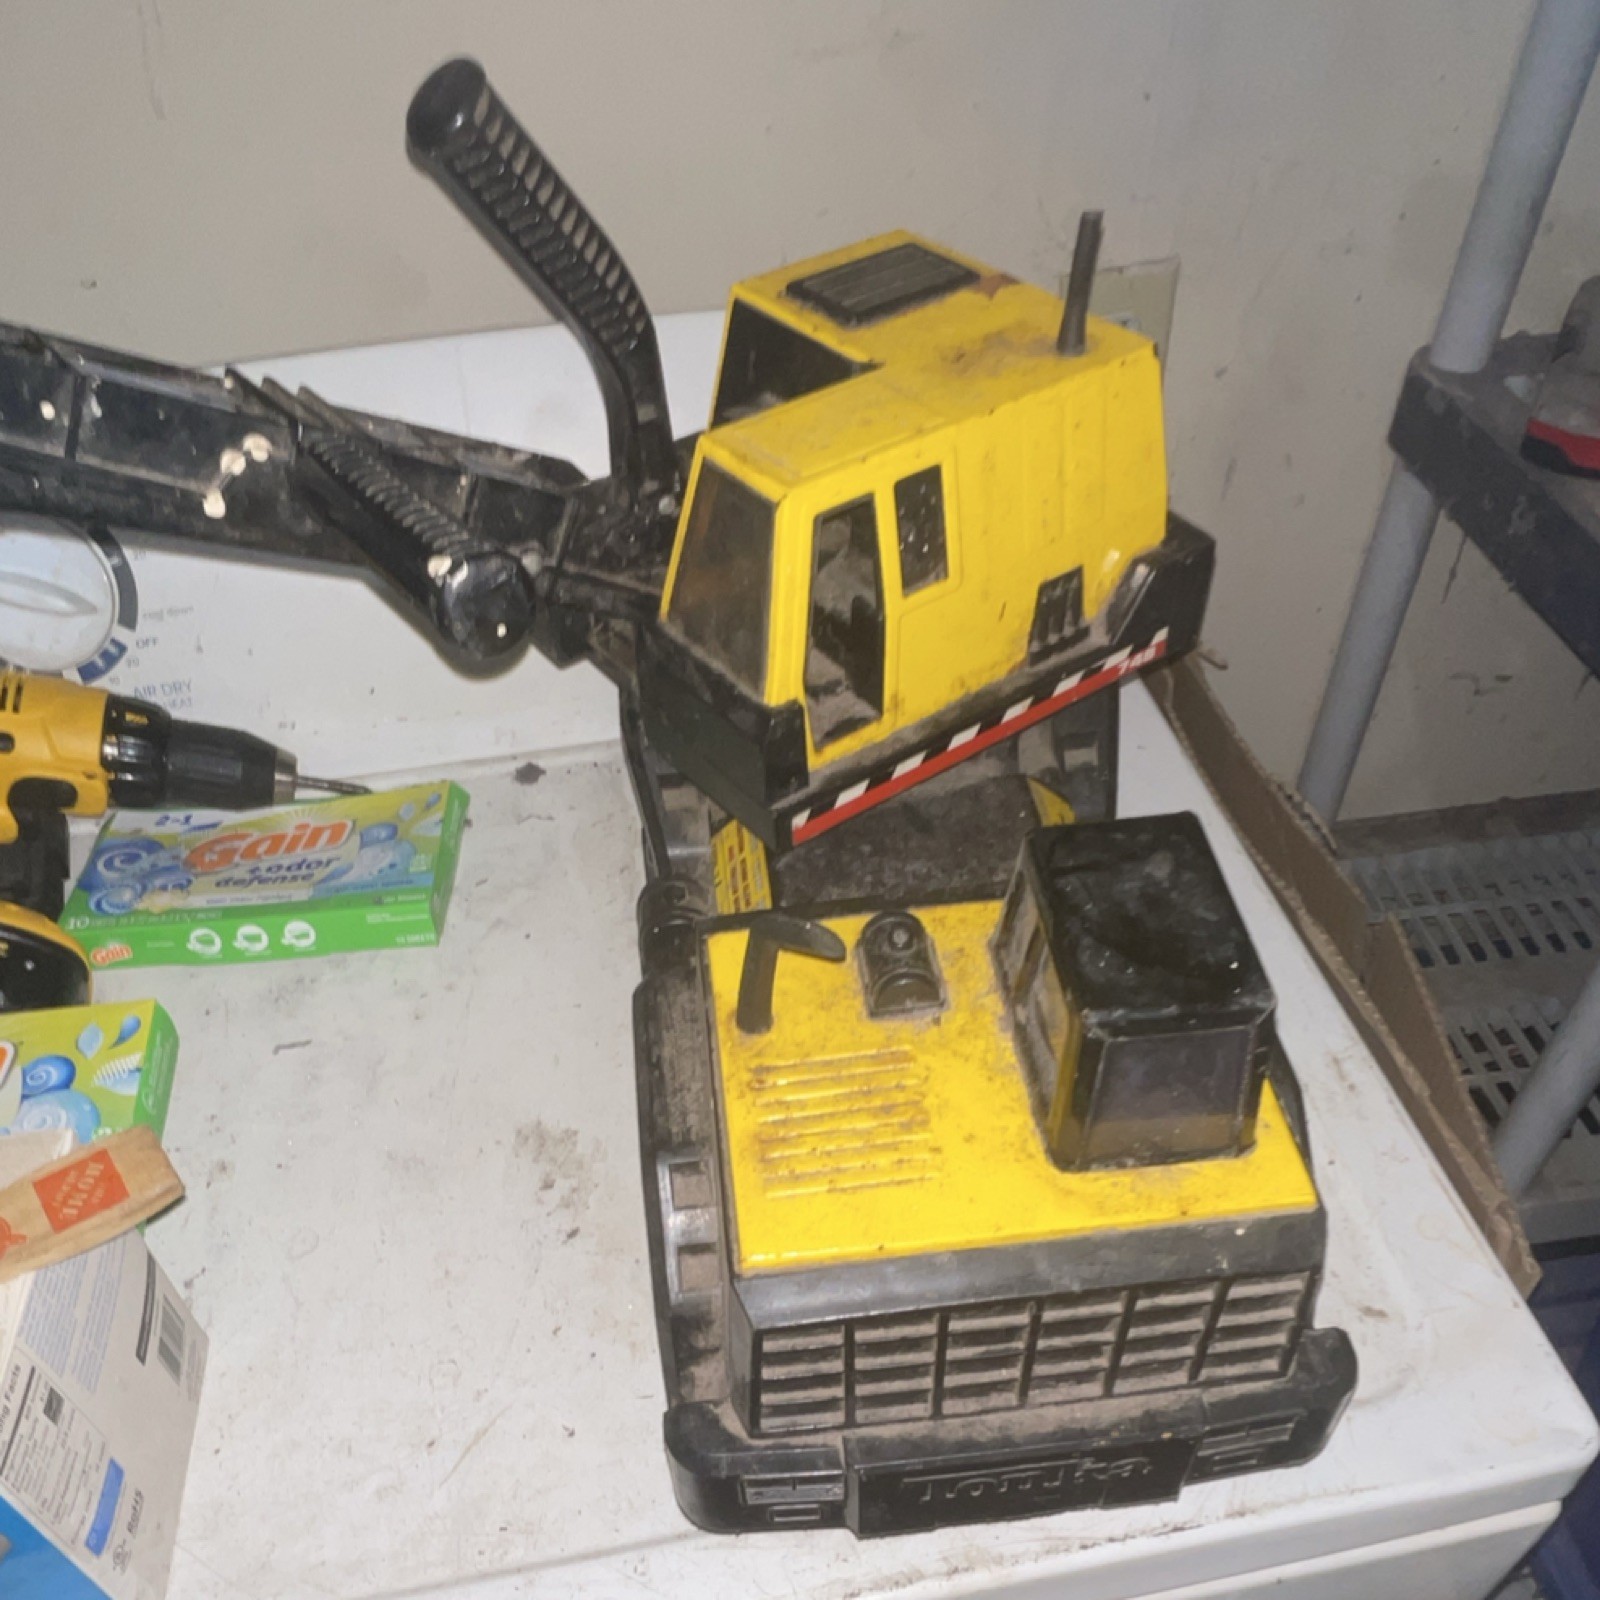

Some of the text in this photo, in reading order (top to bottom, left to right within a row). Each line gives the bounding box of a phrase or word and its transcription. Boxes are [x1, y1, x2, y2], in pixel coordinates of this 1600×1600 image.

[161, 680, 192, 696] DRY
[183, 818, 354, 875] Gain
[266, 857, 341, 874] odor
[215, 873, 314, 888] defense
